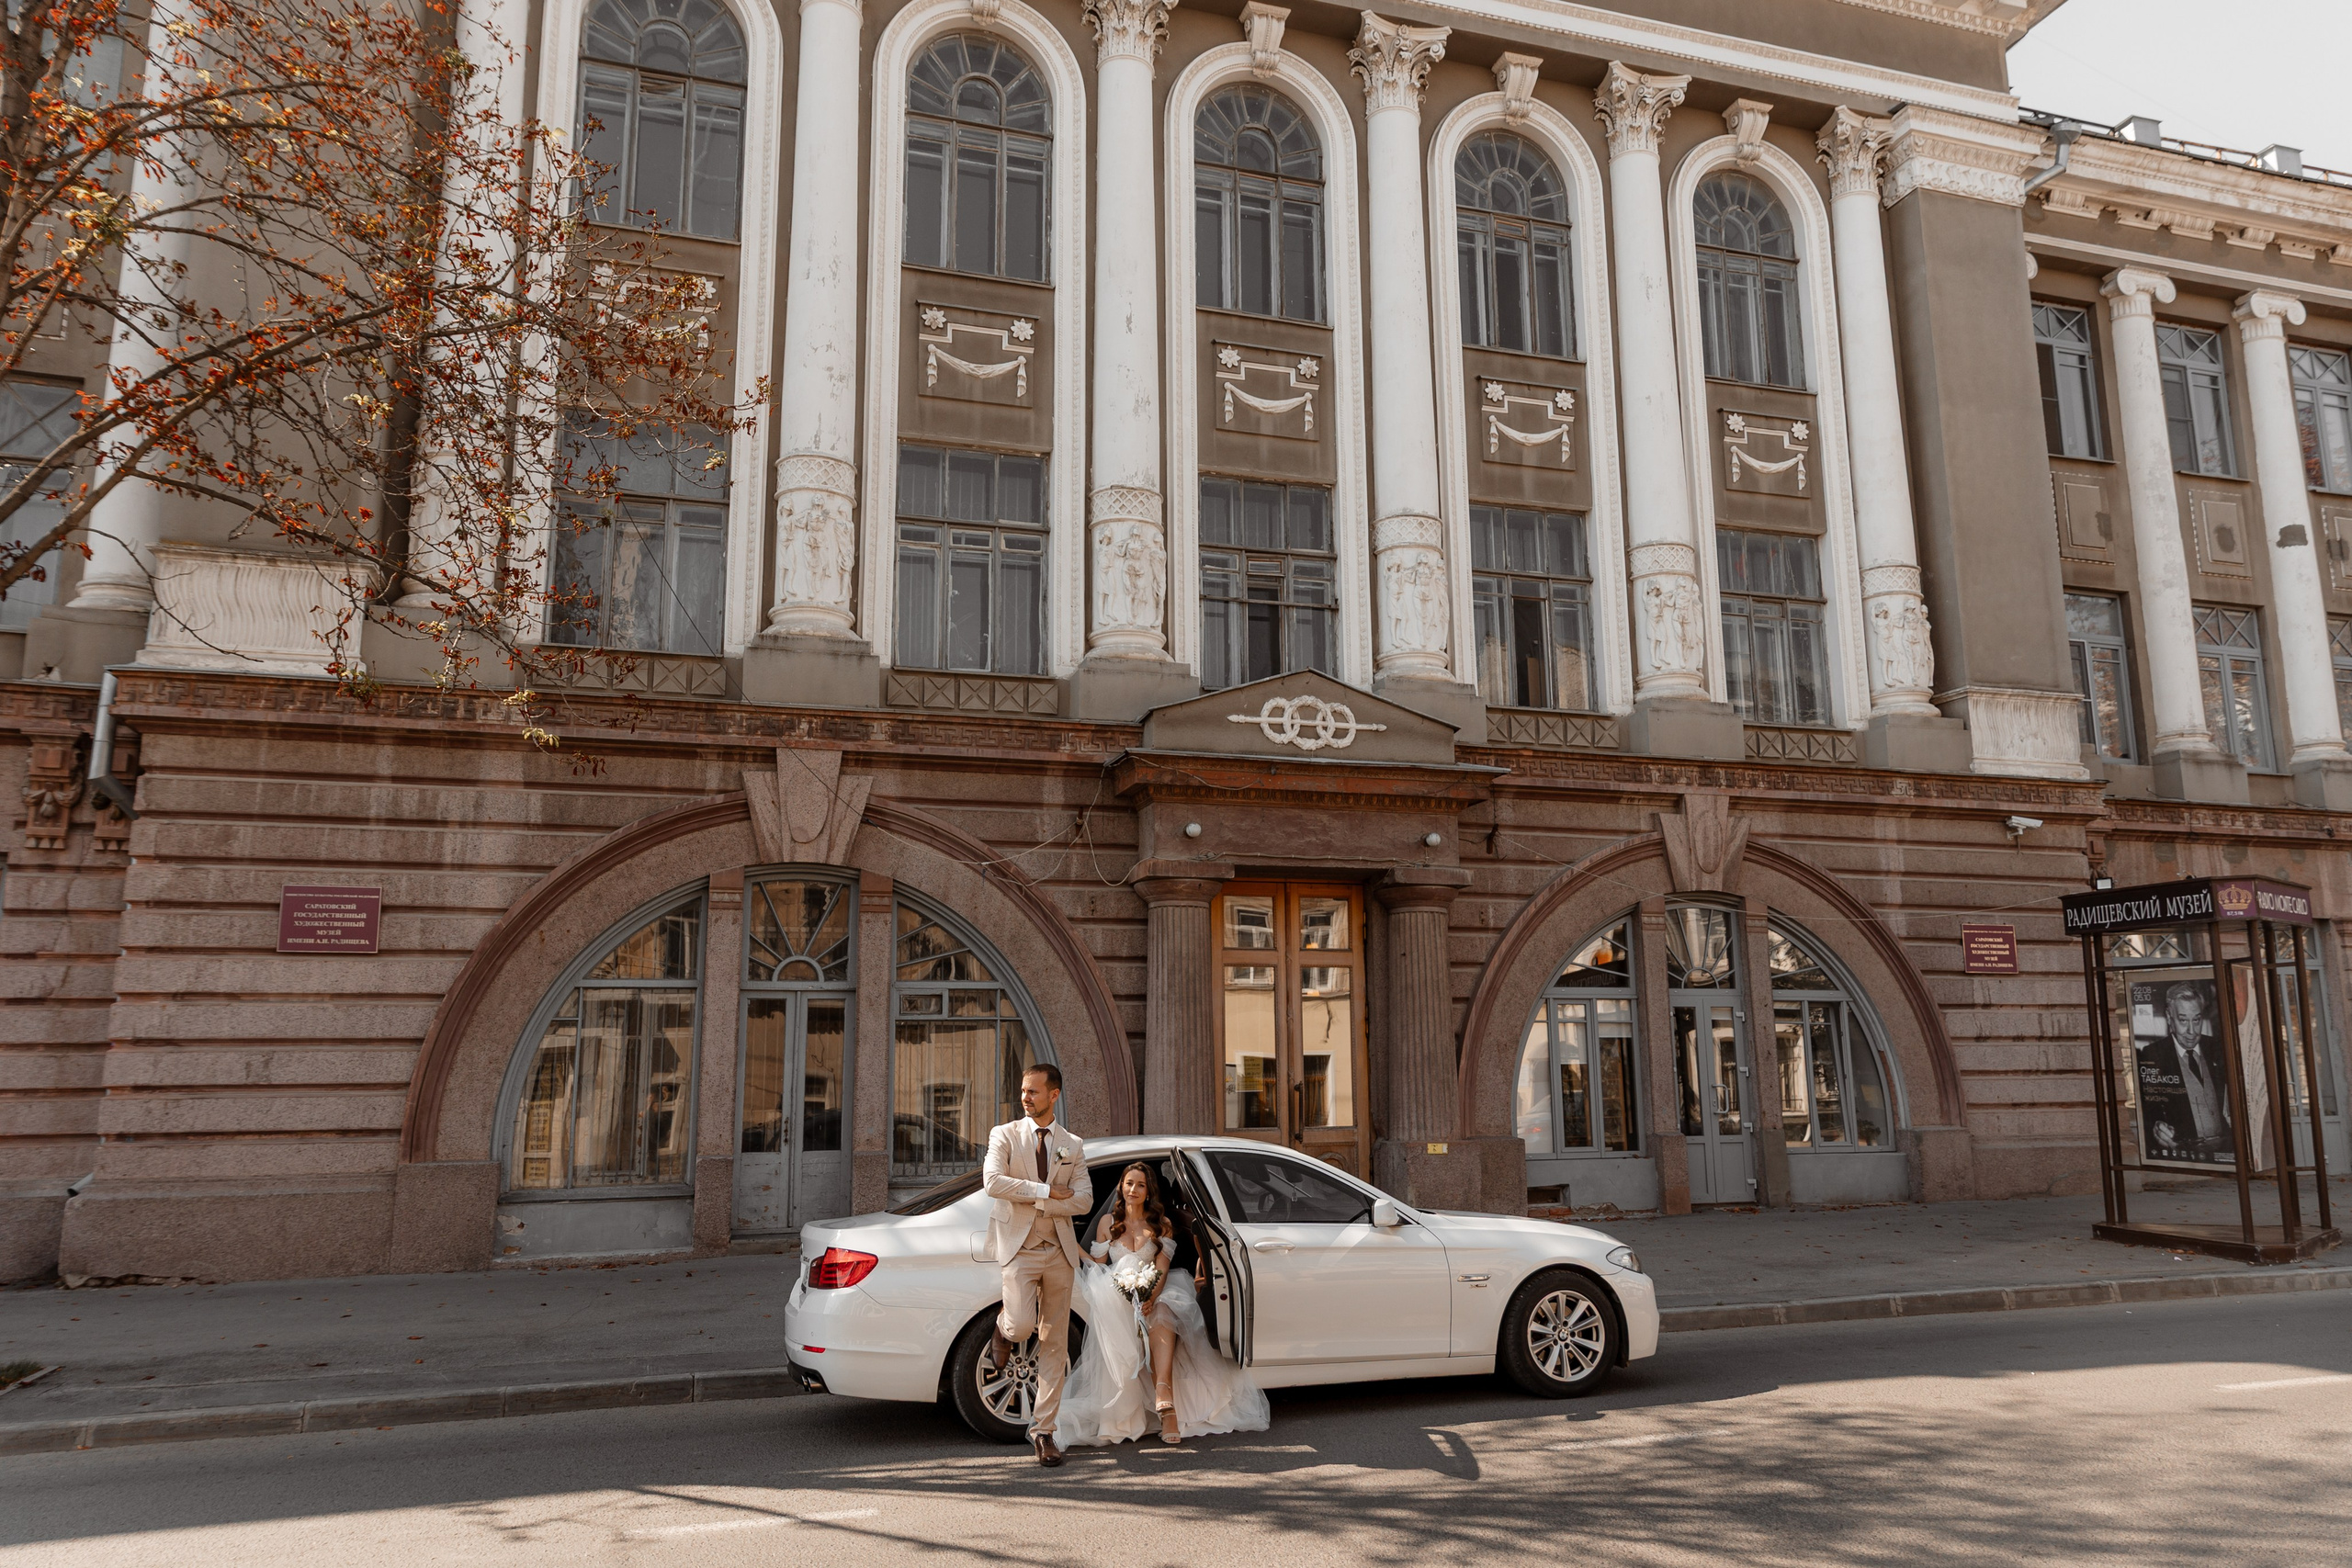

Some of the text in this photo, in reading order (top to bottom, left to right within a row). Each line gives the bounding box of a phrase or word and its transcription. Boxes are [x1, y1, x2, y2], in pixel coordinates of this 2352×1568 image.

[2256, 891, 2275, 910] RADIO
[2066, 888, 2213, 929] РАДИЩЕВСКИЙ МУЗЕЙ
[2140, 1066, 2160, 1075] Олег
[2141, 1074, 2180, 1084] ТАБАКОВ
[2143, 1085, 2188, 1094] Настоящая
